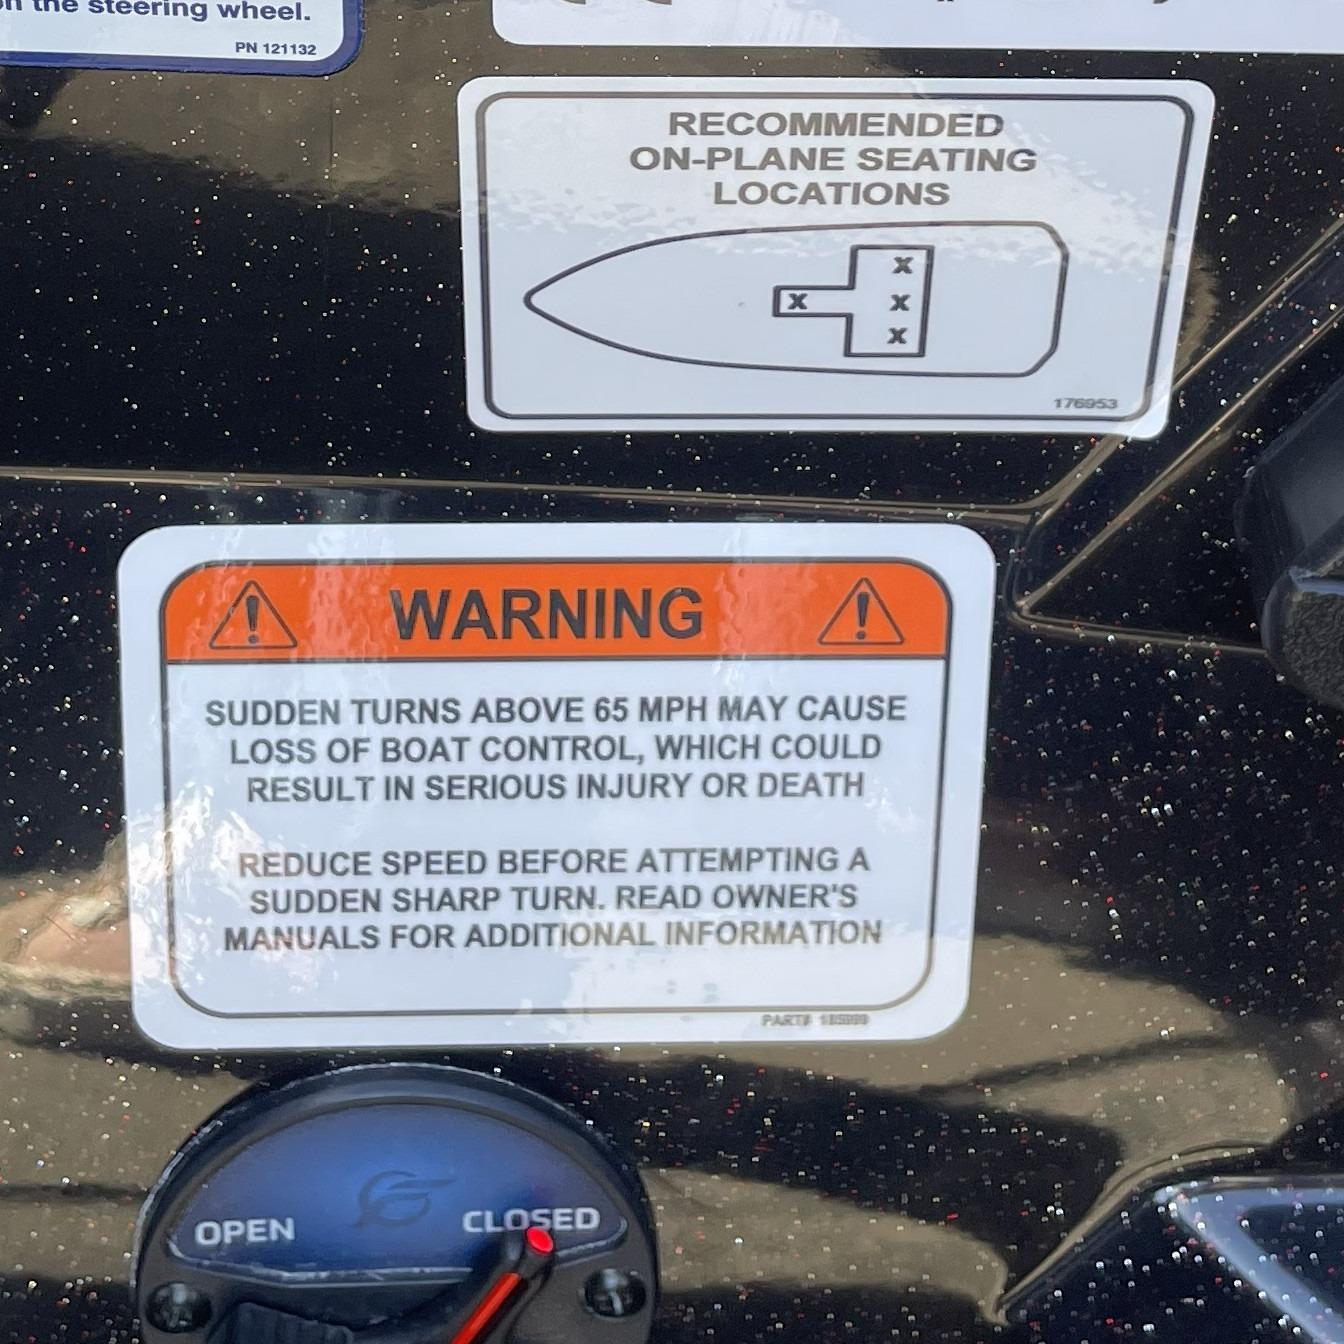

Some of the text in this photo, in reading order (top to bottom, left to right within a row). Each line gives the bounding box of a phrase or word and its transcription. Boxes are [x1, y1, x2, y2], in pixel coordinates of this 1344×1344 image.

[236, 42, 316, 55] PN 121132
[669, 112, 1004, 137] RECOMMENDED
[630, 147, 1036, 172] ON-PLANE SEATING
[714, 181, 950, 206] LOCATIONS
[390, 587, 702, 640] WARNING
[206, 695, 906, 726] SUDDEN TURNS ABOVE 65 MPH MAY CAUSE
[250, 884, 857, 915] SUDDEN SHARP TURN. READ OWNER'S
[194, 1217, 296, 1246] OPEN
[462, 1207, 600, 1233] CLOSED
